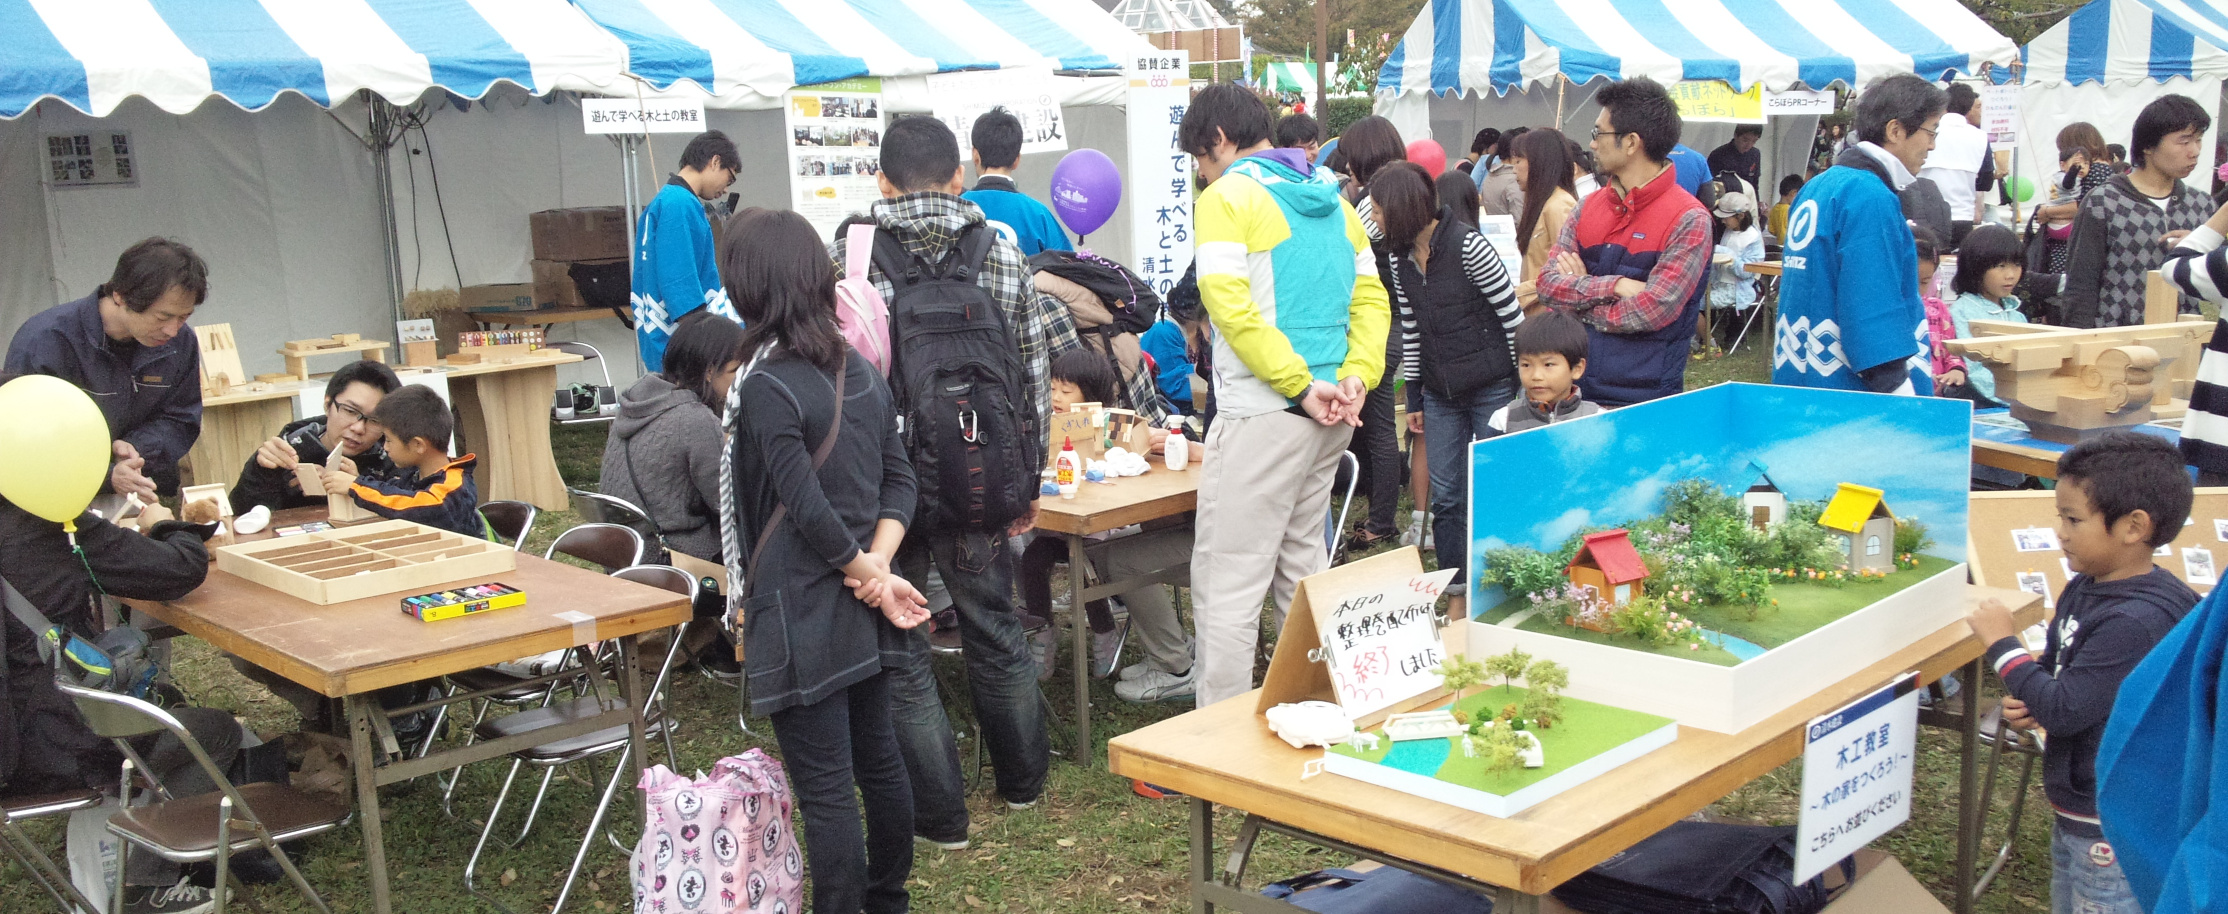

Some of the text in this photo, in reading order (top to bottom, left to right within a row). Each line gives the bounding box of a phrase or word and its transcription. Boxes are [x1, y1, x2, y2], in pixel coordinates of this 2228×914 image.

[1137, 57, 1181, 71] 協賛企業
[591, 109, 699, 123] 遊んで学べる木と土の教室
[1768, 98, 1827, 107] こらぼらPRコーナー
[1156, 206, 1174, 312] 木と土の
[1333, 593, 1384, 618] 本日の
[1353, 645, 1390, 684] 終了
[1836, 722, 1891, 770] 木工教室
[1811, 791, 1902, 852] こちらへお並びください
